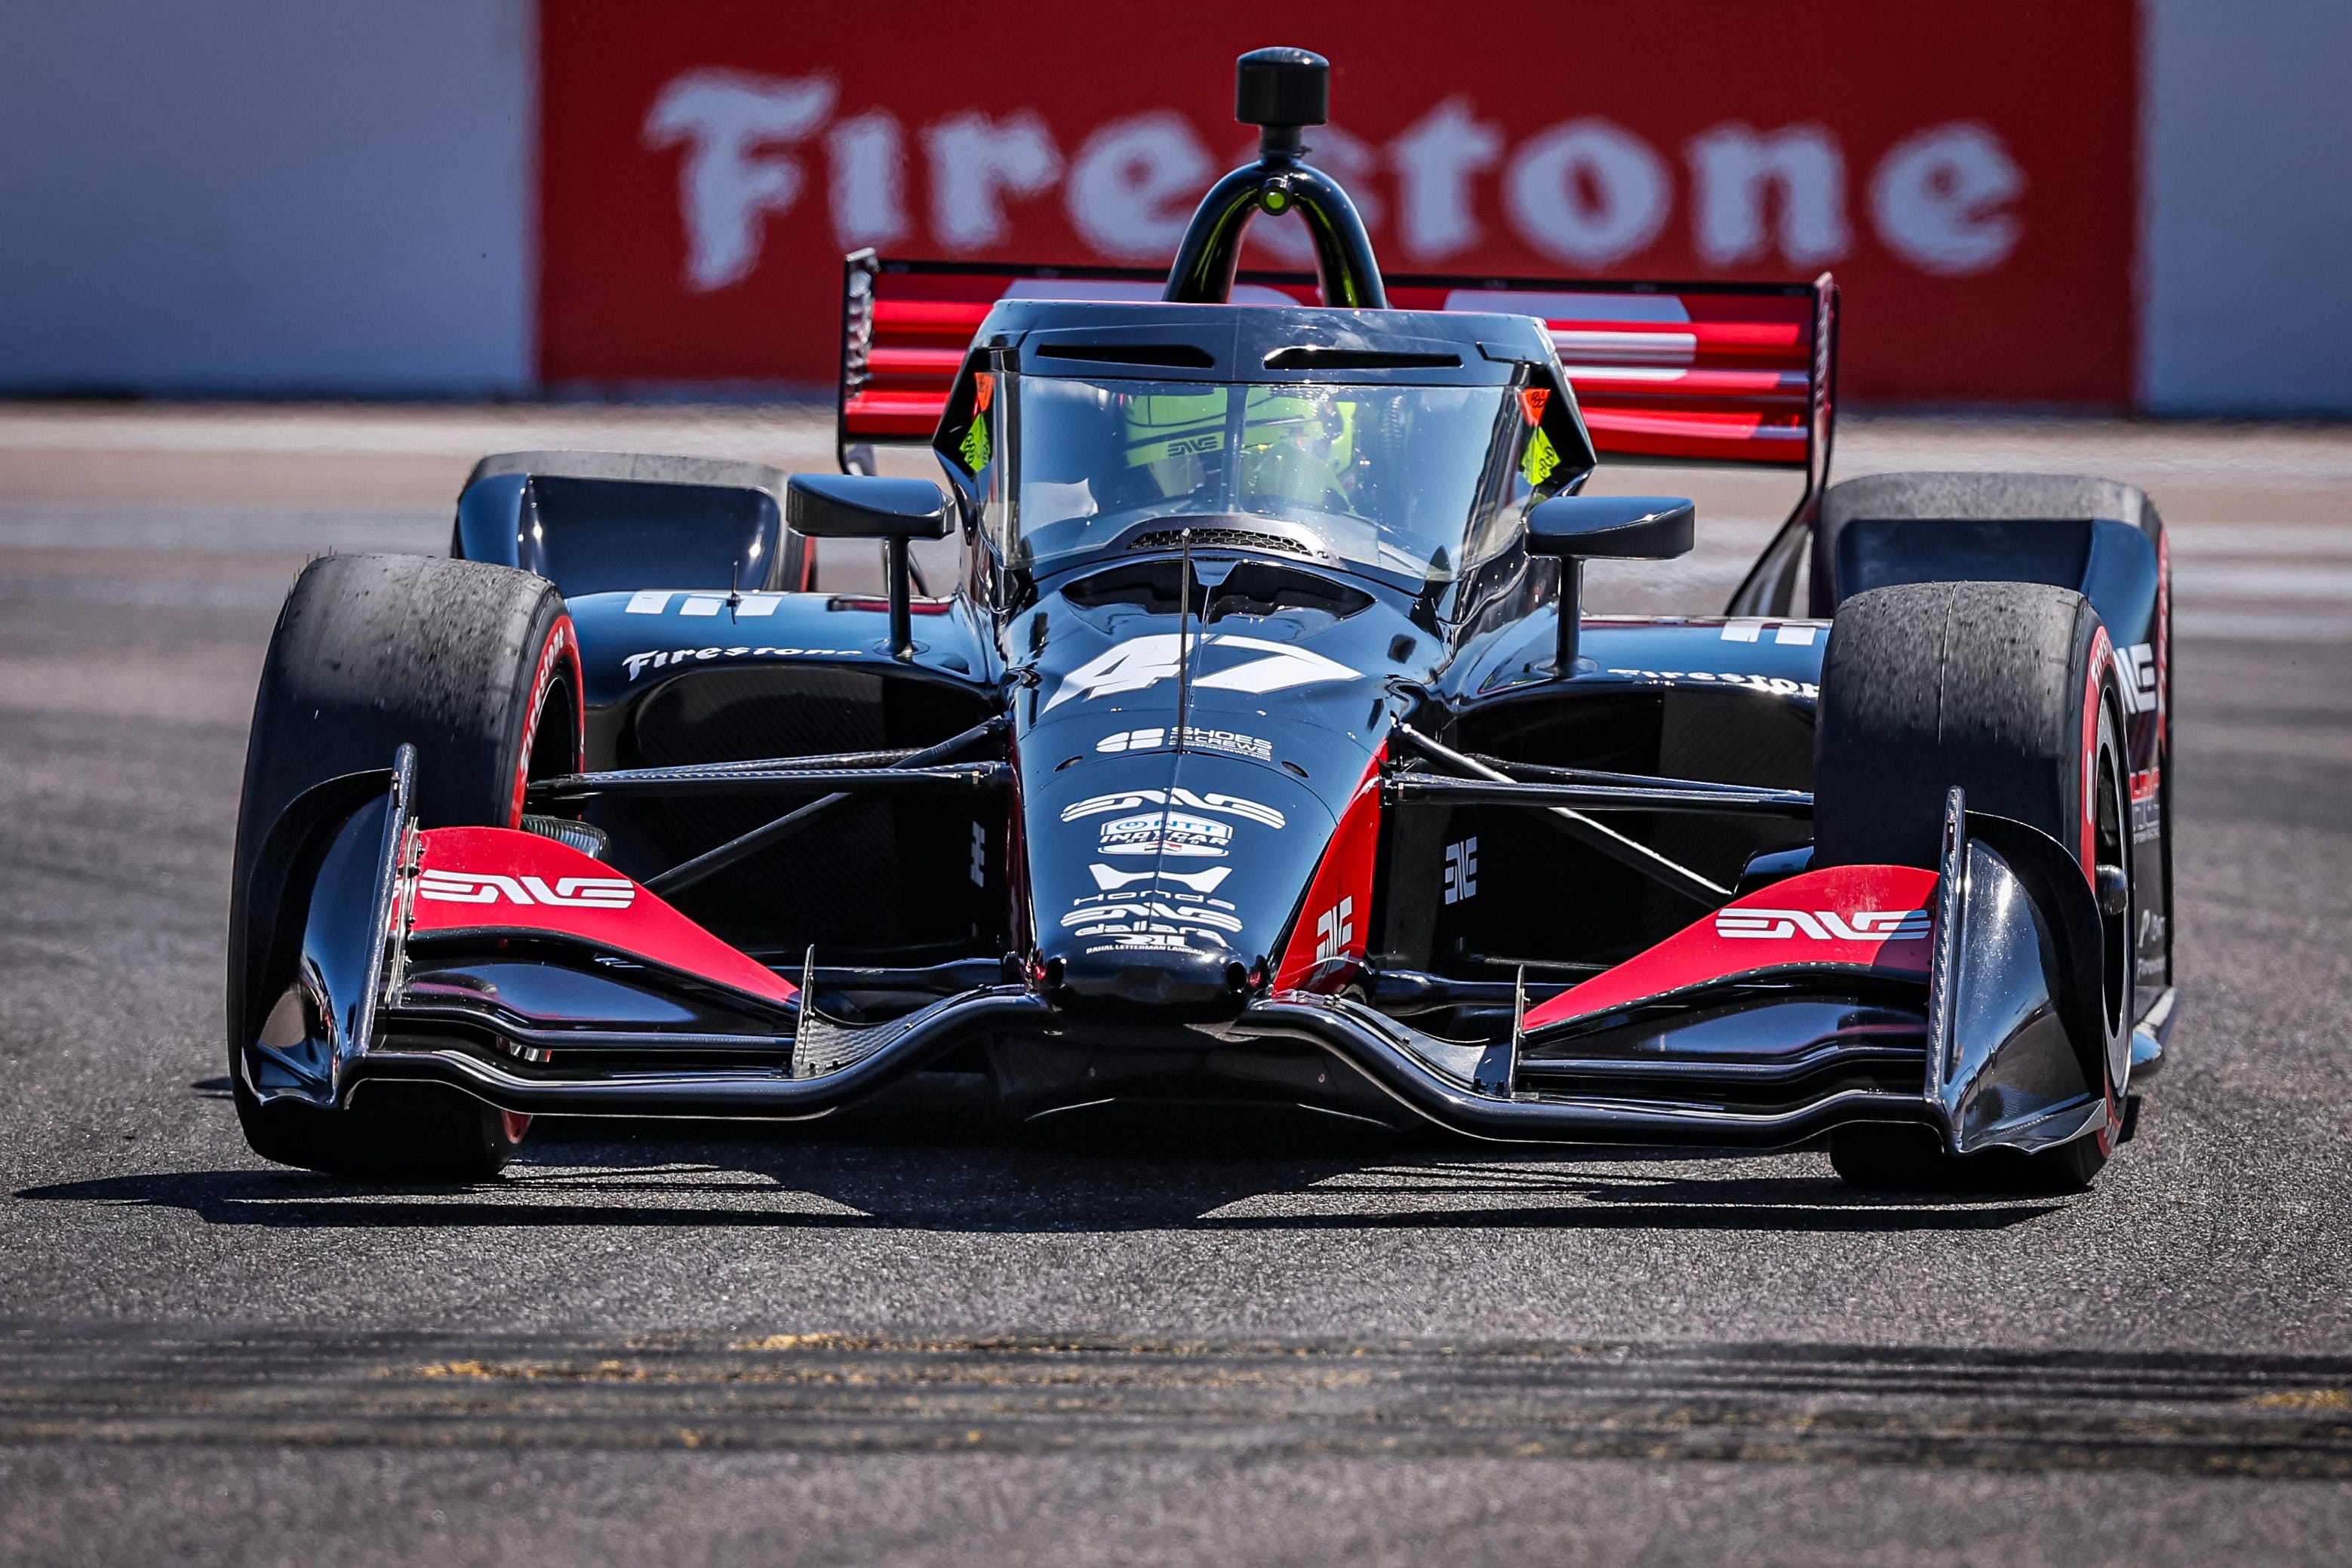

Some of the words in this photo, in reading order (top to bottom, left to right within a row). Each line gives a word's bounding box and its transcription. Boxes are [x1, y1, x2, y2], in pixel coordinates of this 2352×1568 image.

[622, 647, 863, 682] Firestone
[1038, 632, 1365, 717] 47
[1607, 668, 1820, 698] Fireston
[1170, 726, 1273, 750] SHOES
[1194, 736, 1272, 756] CREWS
[1099, 829, 1231, 846] INDYCAR
[1154, 819, 1218, 832] NTT
[1074, 921, 1231, 948] dallara
[1086, 945, 1115, 955] RAHAL
